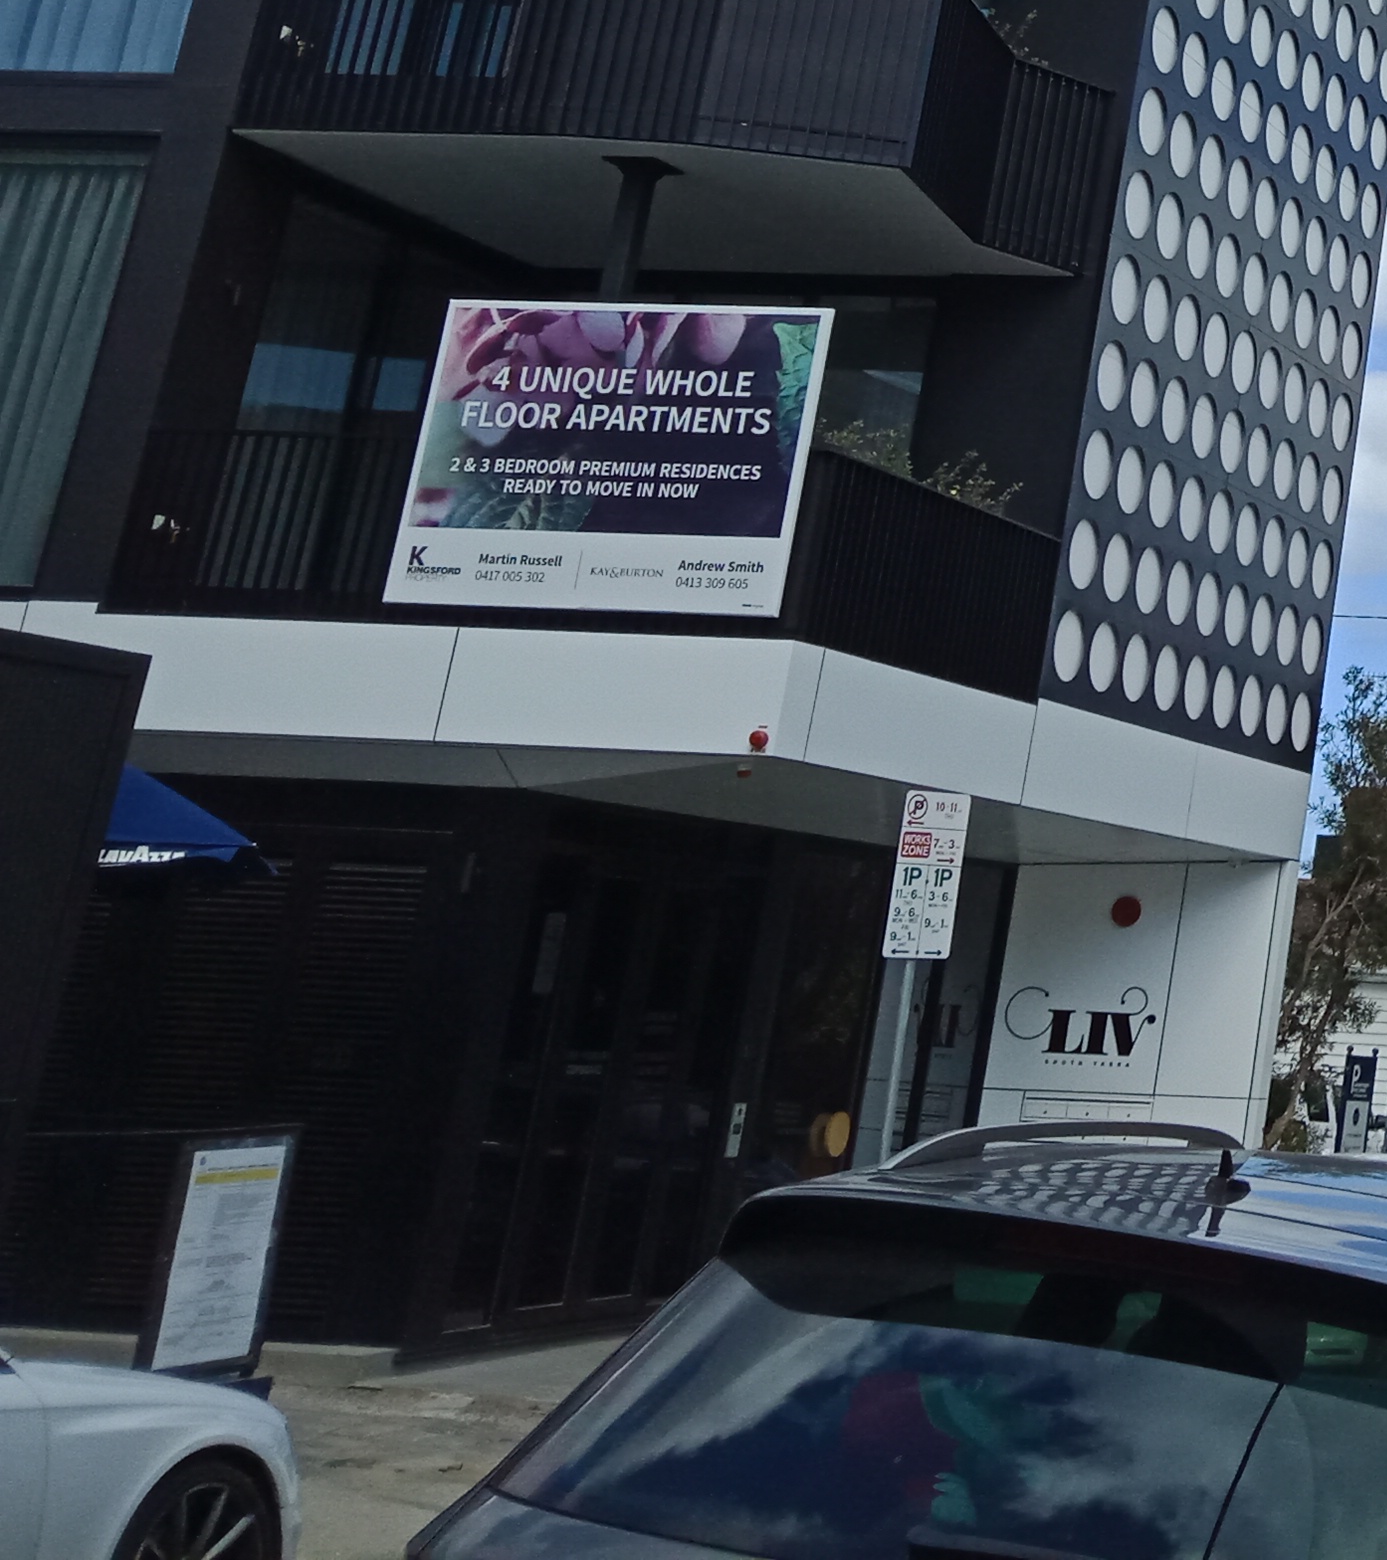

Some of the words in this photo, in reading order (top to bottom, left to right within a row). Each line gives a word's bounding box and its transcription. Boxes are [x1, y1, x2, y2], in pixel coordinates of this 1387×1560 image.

[491, 365, 512, 392] 4
[519, 365, 638, 400] UNIQUE
[645, 369, 756, 398] WHOLE
[460, 399, 562, 430] FLOOR
[565, 403, 772, 435] APARTMENTS
[449, 457, 461, 473] 2
[463, 457, 477, 473] &
[479, 457, 491, 473] 3
[493, 458, 576, 476] BEDROOM
[578, 460, 657, 478] PREMIUM
[659, 463, 762, 481] RESIDENCES
[503, 478, 558, 494] READY
[559, 479, 582, 496] TO
[585, 480, 634, 497] MOVE
[636, 482, 655, 498] IN
[657, 482, 700, 499] NOW
[408, 545, 429, 566] K
[478, 553, 517, 566] Martin
[519, 554, 563, 567] Russell
[406, 565, 462, 576] KINGSFORD
[677, 559, 726, 572] Andrew
[727, 561, 764, 573] Smith
[475, 569, 500, 582] 0417
[502, 570, 523, 582] 005
[524, 571, 546, 583] 302
[675, 576, 702, 589] 0413
[704, 577, 726, 589] 309
[727, 578, 749, 590] 605
[903, 834, 931, 845] WORKS
[902, 845, 929, 856] ZONE
[903, 866, 922, 886] 1P
[934, 868, 953, 887] 1P
[1351, 1064, 1362, 1094] P
